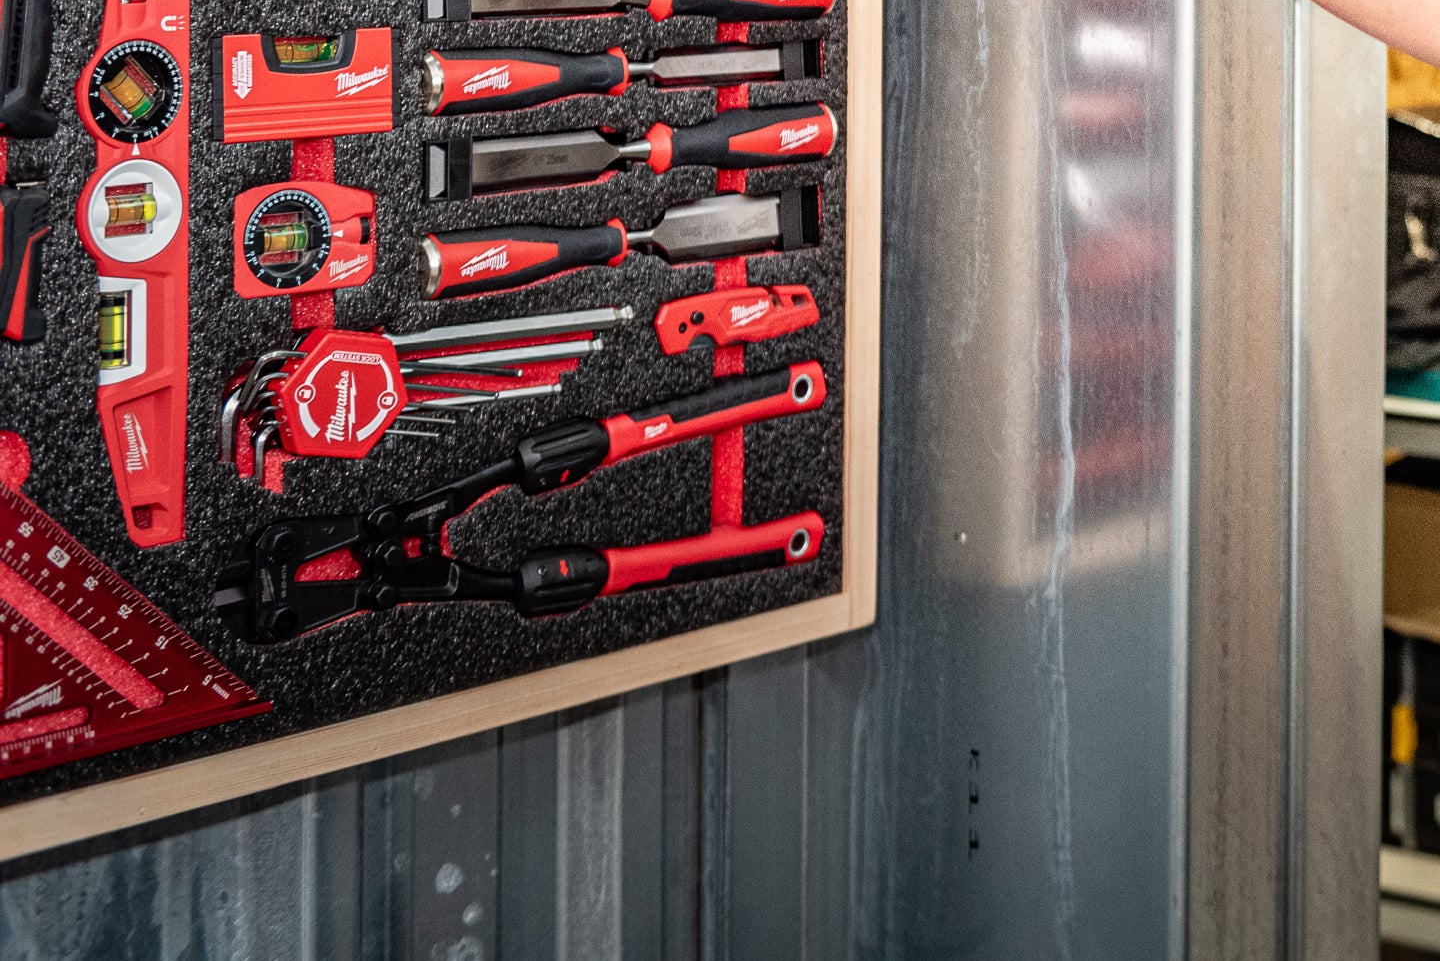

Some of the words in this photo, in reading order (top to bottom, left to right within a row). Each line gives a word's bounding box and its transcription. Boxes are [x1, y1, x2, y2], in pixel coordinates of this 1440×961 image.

[334, 64, 390, 92] Milwaukee
[463, 71, 512, 95] Milwaukee
[779, 124, 819, 146] Milwaukee
[328, 254, 369, 278] Milwaukee
[461, 251, 510, 277] Milwaukee
[730, 299, 770, 323] Milwaukee
[325, 370, 349, 444] Milwaukee
[122, 413, 144, 475] Milwaukee
[18, 522, 34, 538] 55
[51, 549, 66, 564] 45
[83, 576, 99, 592] 35
[117, 604, 133, 620] 25
[155, 635, 169, 650] 15
[201, 674, 213, 686] 5
[4, 685, 65, 719] Milwaukee
